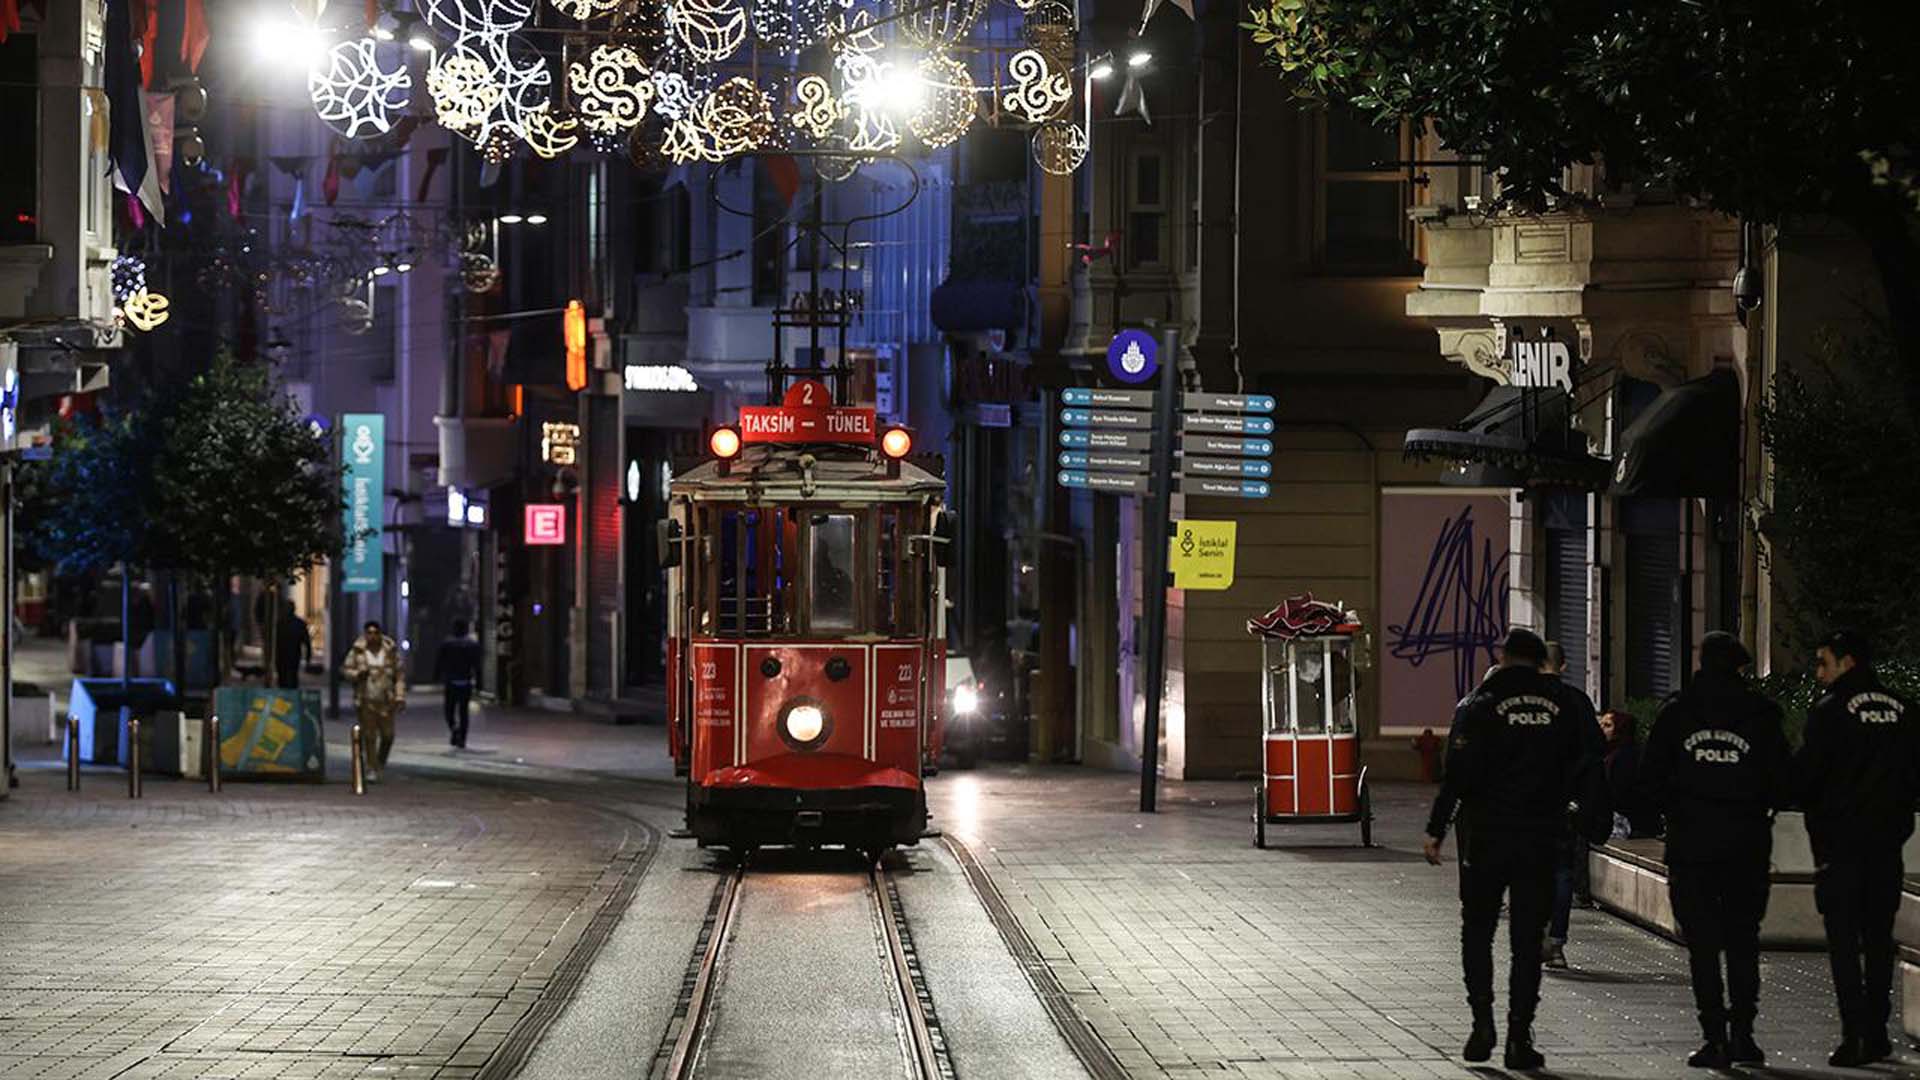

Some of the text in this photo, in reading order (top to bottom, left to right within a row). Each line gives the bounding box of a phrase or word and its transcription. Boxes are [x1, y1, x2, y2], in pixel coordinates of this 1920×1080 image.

[803, 383, 813, 405] 2
[744, 411, 795, 433] TAKSİM
[827, 410, 871, 433] TÜNEL
[534, 511, 557, 536] E
